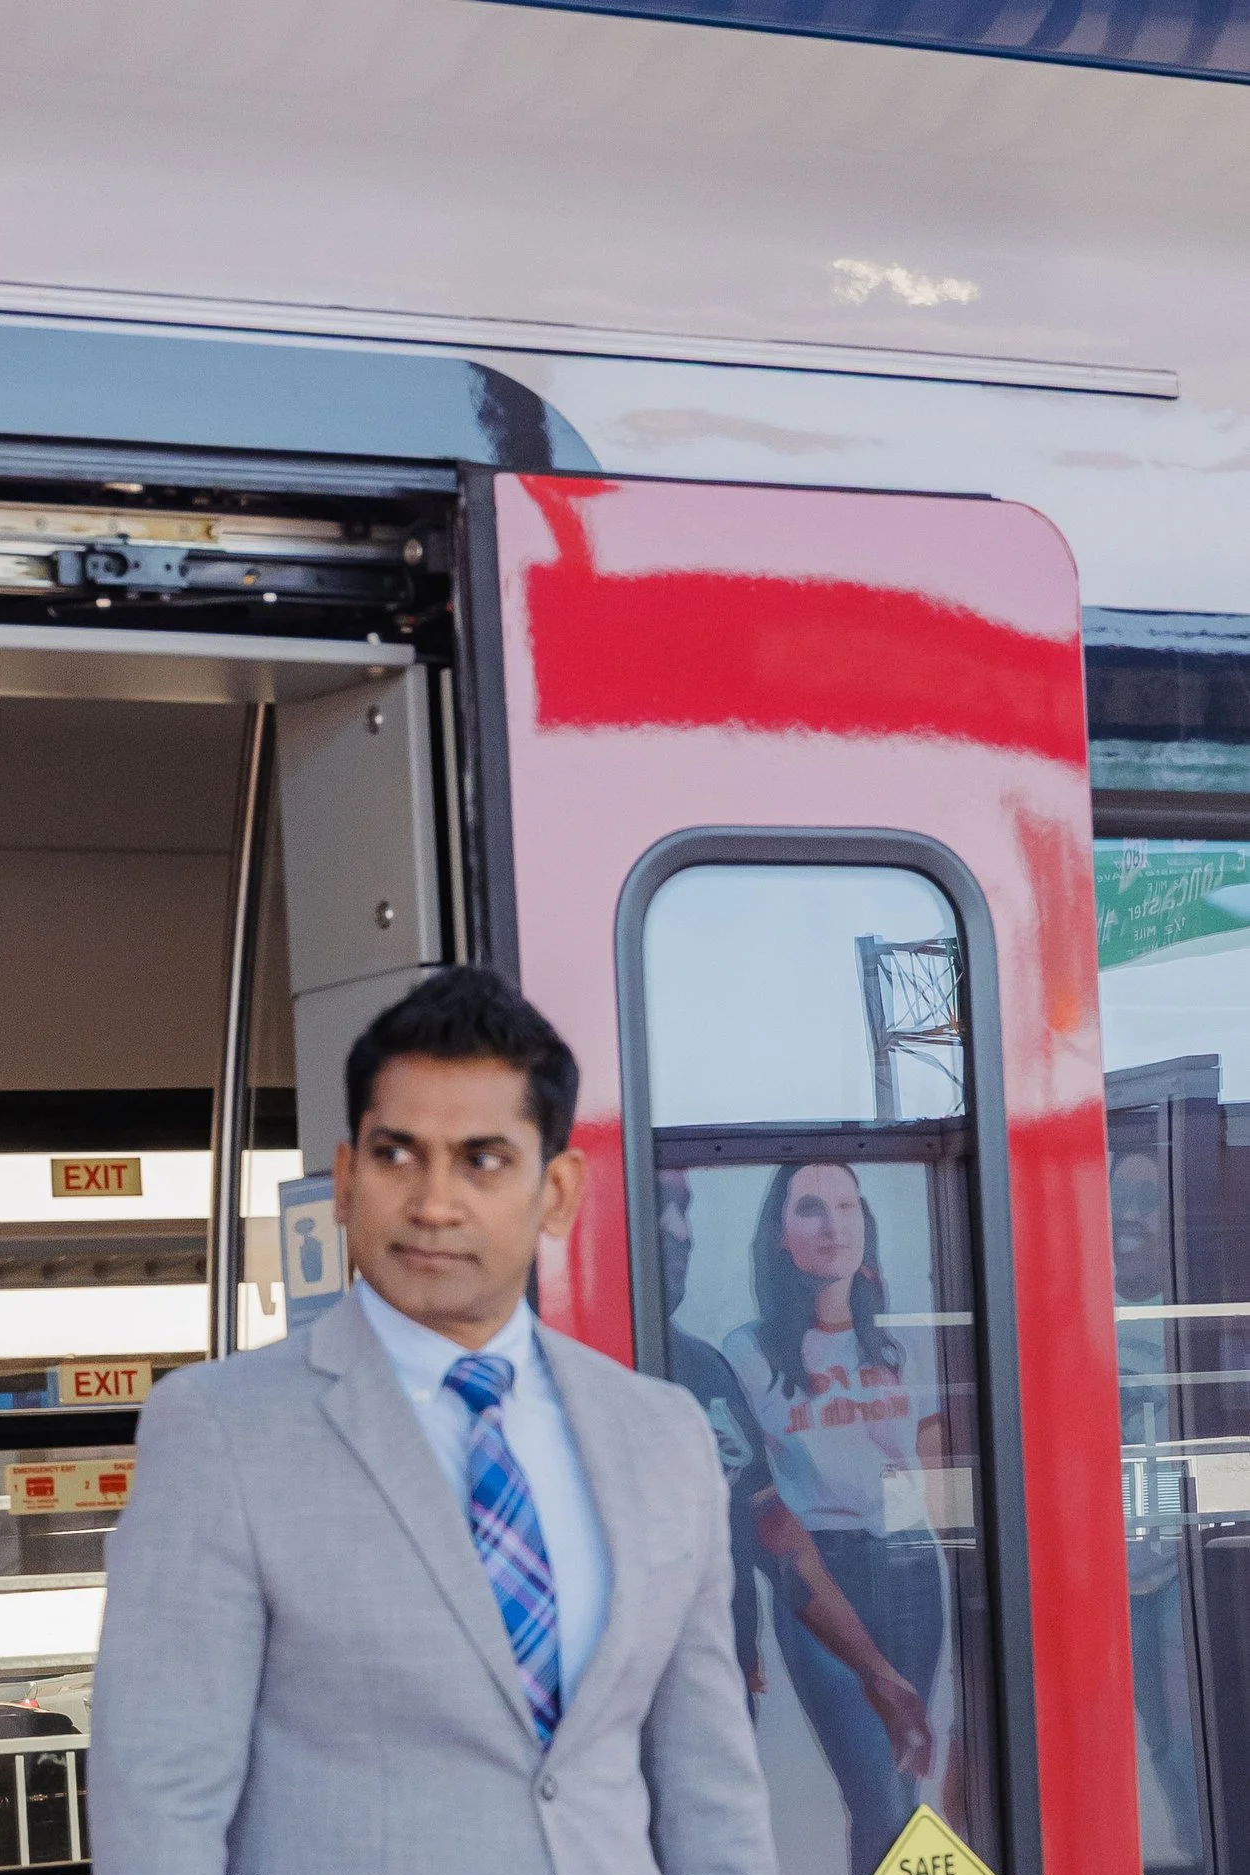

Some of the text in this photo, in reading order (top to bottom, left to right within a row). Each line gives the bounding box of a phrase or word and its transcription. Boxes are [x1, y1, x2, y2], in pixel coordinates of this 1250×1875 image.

[64, 1164, 128, 1190] EXIT
[74, 1369, 138, 1397] EXIT
[60, 1464, 77, 1472] EXIT
